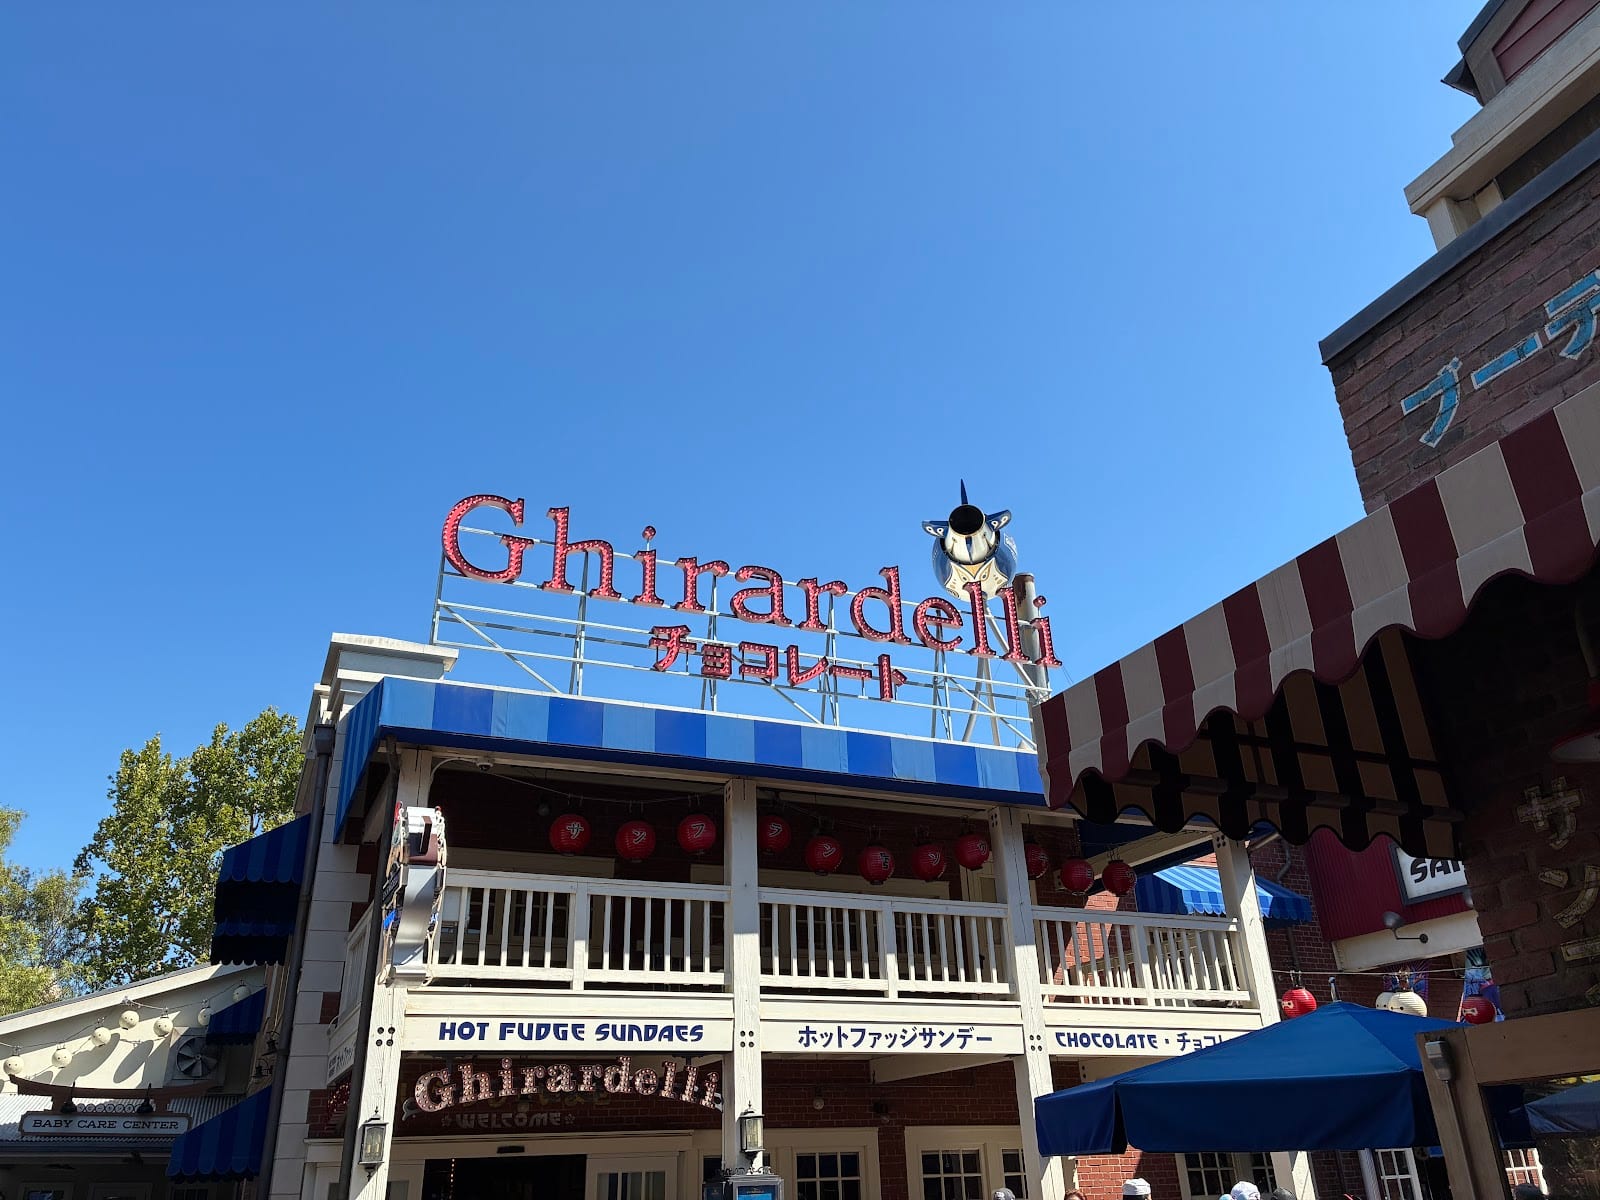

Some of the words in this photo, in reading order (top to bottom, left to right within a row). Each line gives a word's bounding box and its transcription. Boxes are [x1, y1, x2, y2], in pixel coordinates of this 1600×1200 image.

[441, 494, 1063, 668] Ghirardelli
[649, 625, 909, 701] チョコレート
[438, 1021, 490, 1041] HOT
[498, 1022, 585, 1042] FUDGE
[595, 1023, 704, 1042] SUNDAES
[798, 1025, 993, 1050] ホットファッジサンデー
[1055, 1031, 1159, 1049] CHOCOLATE
[414, 1056, 720, 1112] Ghirardelli
[32, 1118, 73, 1130] BABY
[77, 1118, 118, 1130] CARE
[122, 1119, 180, 1130] CENTER
[455, 1112, 562, 1129] WELCOME
